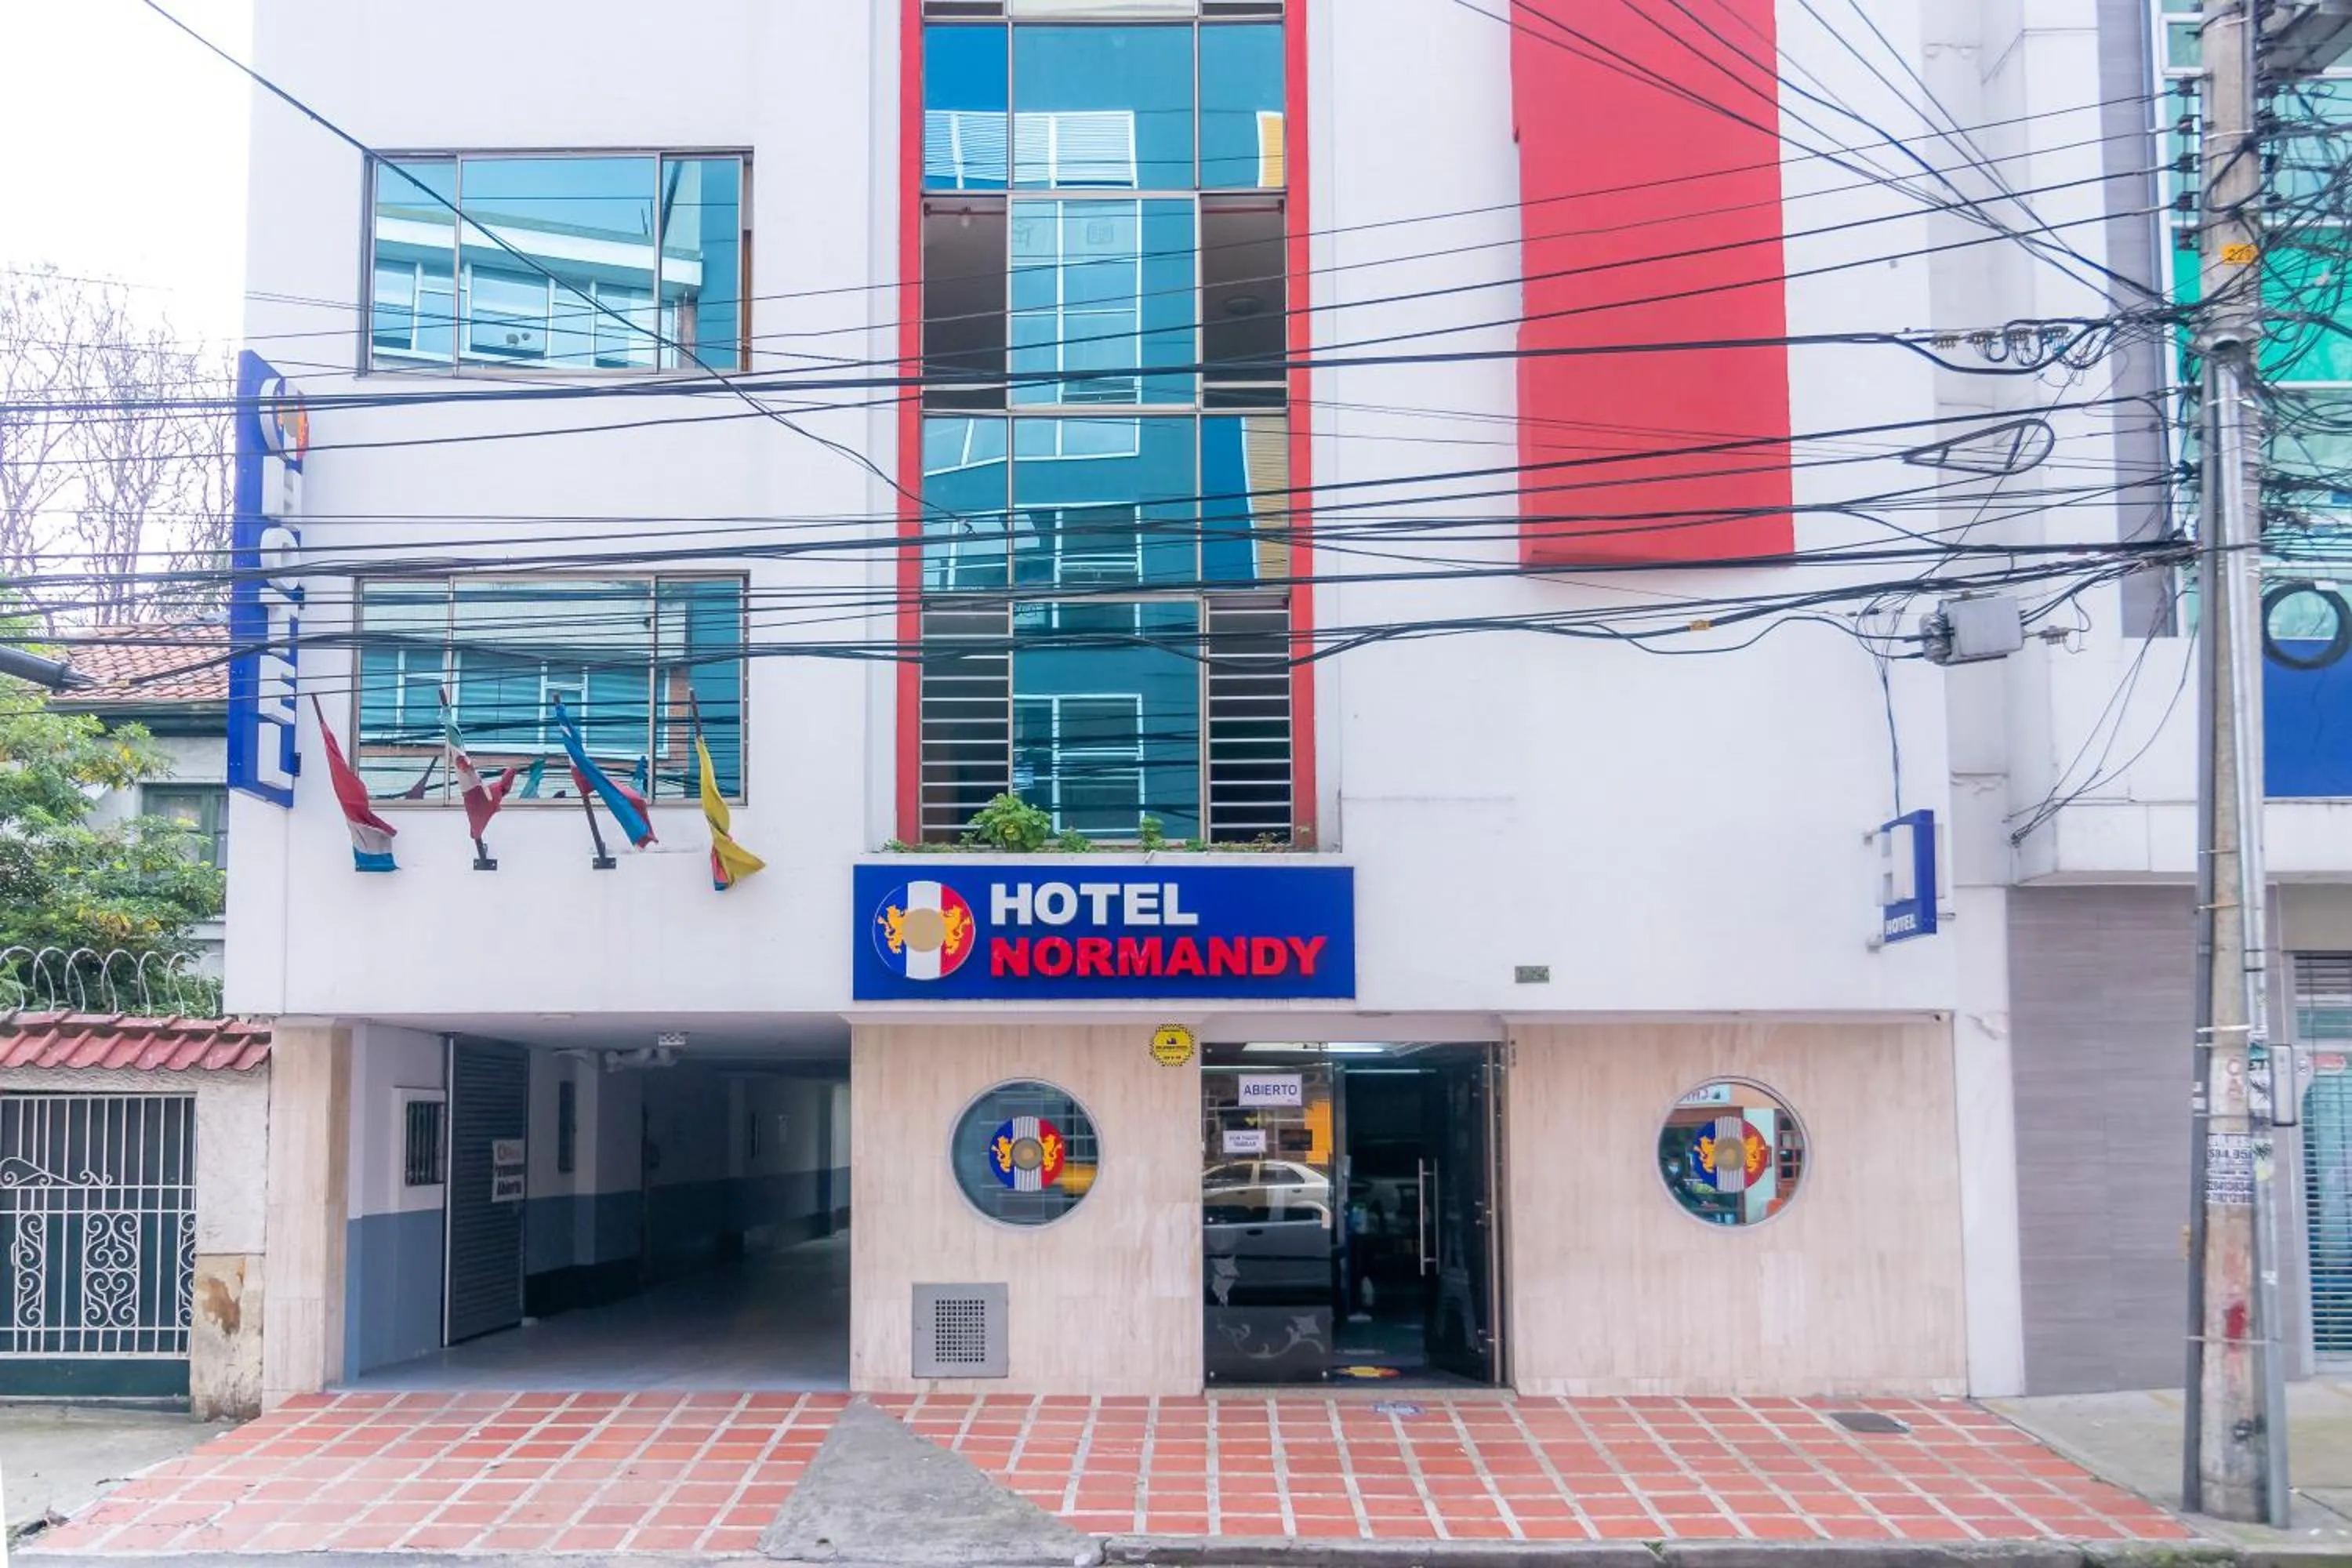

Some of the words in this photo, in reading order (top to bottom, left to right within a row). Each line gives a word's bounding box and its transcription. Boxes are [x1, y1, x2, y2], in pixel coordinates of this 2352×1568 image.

[258, 455, 303, 790] HOTEL
[990, 883, 1198, 926] HOTEL
[1886, 913, 1917, 935] HOTEL
[990, 936, 1327, 976] NORMANDY
[1243, 1084, 1298, 1095] ABIERTO
